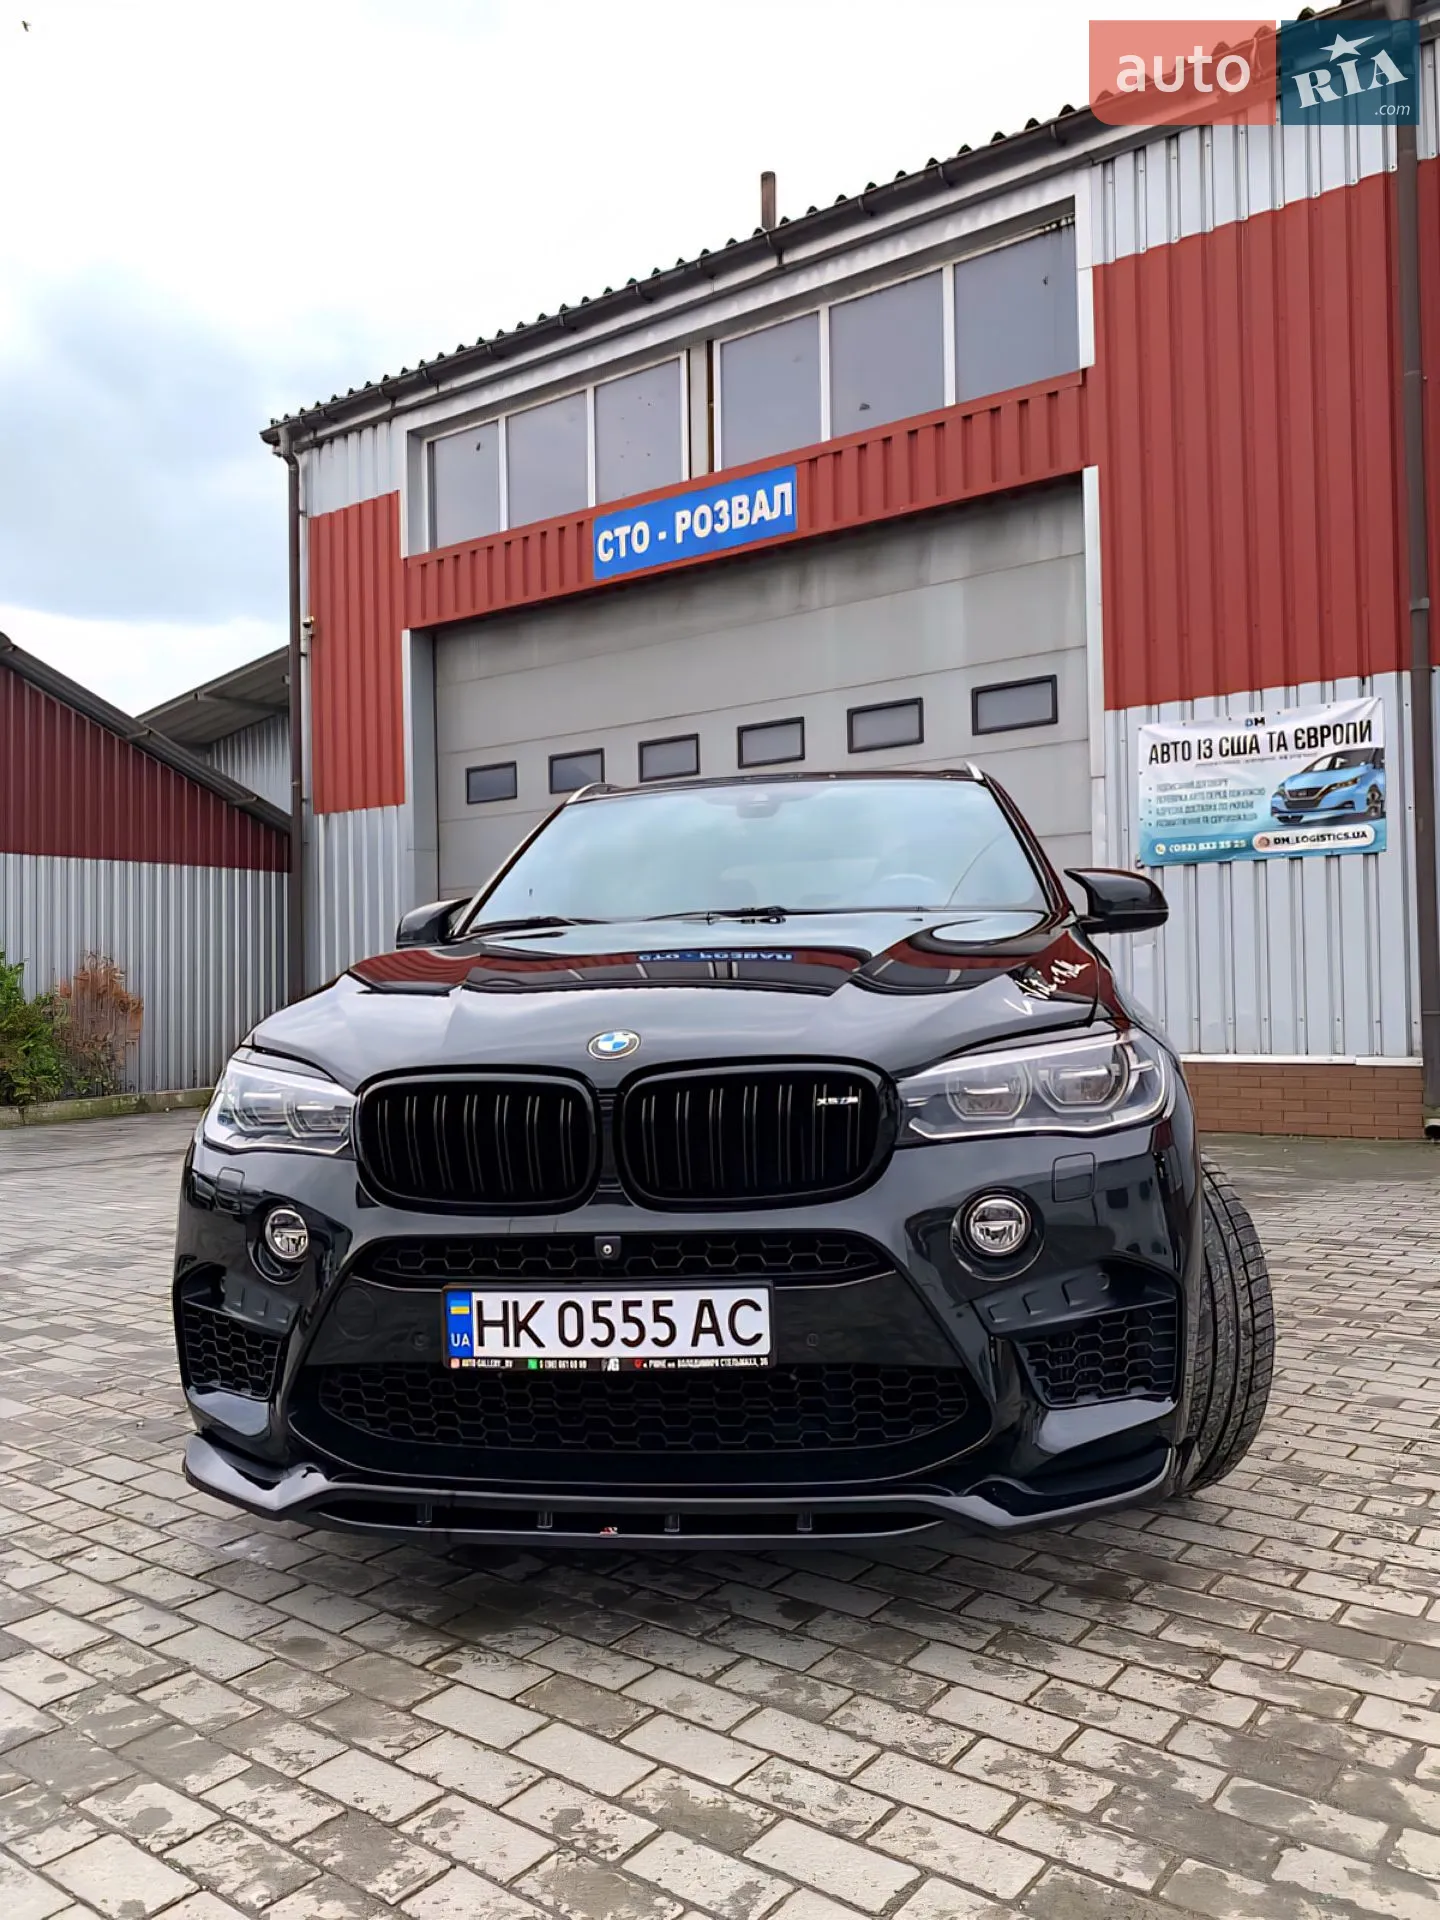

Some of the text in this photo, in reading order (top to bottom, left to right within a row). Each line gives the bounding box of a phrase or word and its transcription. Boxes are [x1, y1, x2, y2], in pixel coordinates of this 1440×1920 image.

[597, 521, 650, 563] СТО
[675, 482, 793, 544] РОЗВАЛ
[1148, 739, 1192, 766] АВТО
[1197, 738, 1213, 760] ІЗ
[1219, 731, 1261, 757] США
[1267, 730, 1289, 753] ТА
[1294, 719, 1373, 750] ЄВРОПИ
[450, 1333, 471, 1348] UA
[476, 1298, 764, 1348] HK 0555 AC
